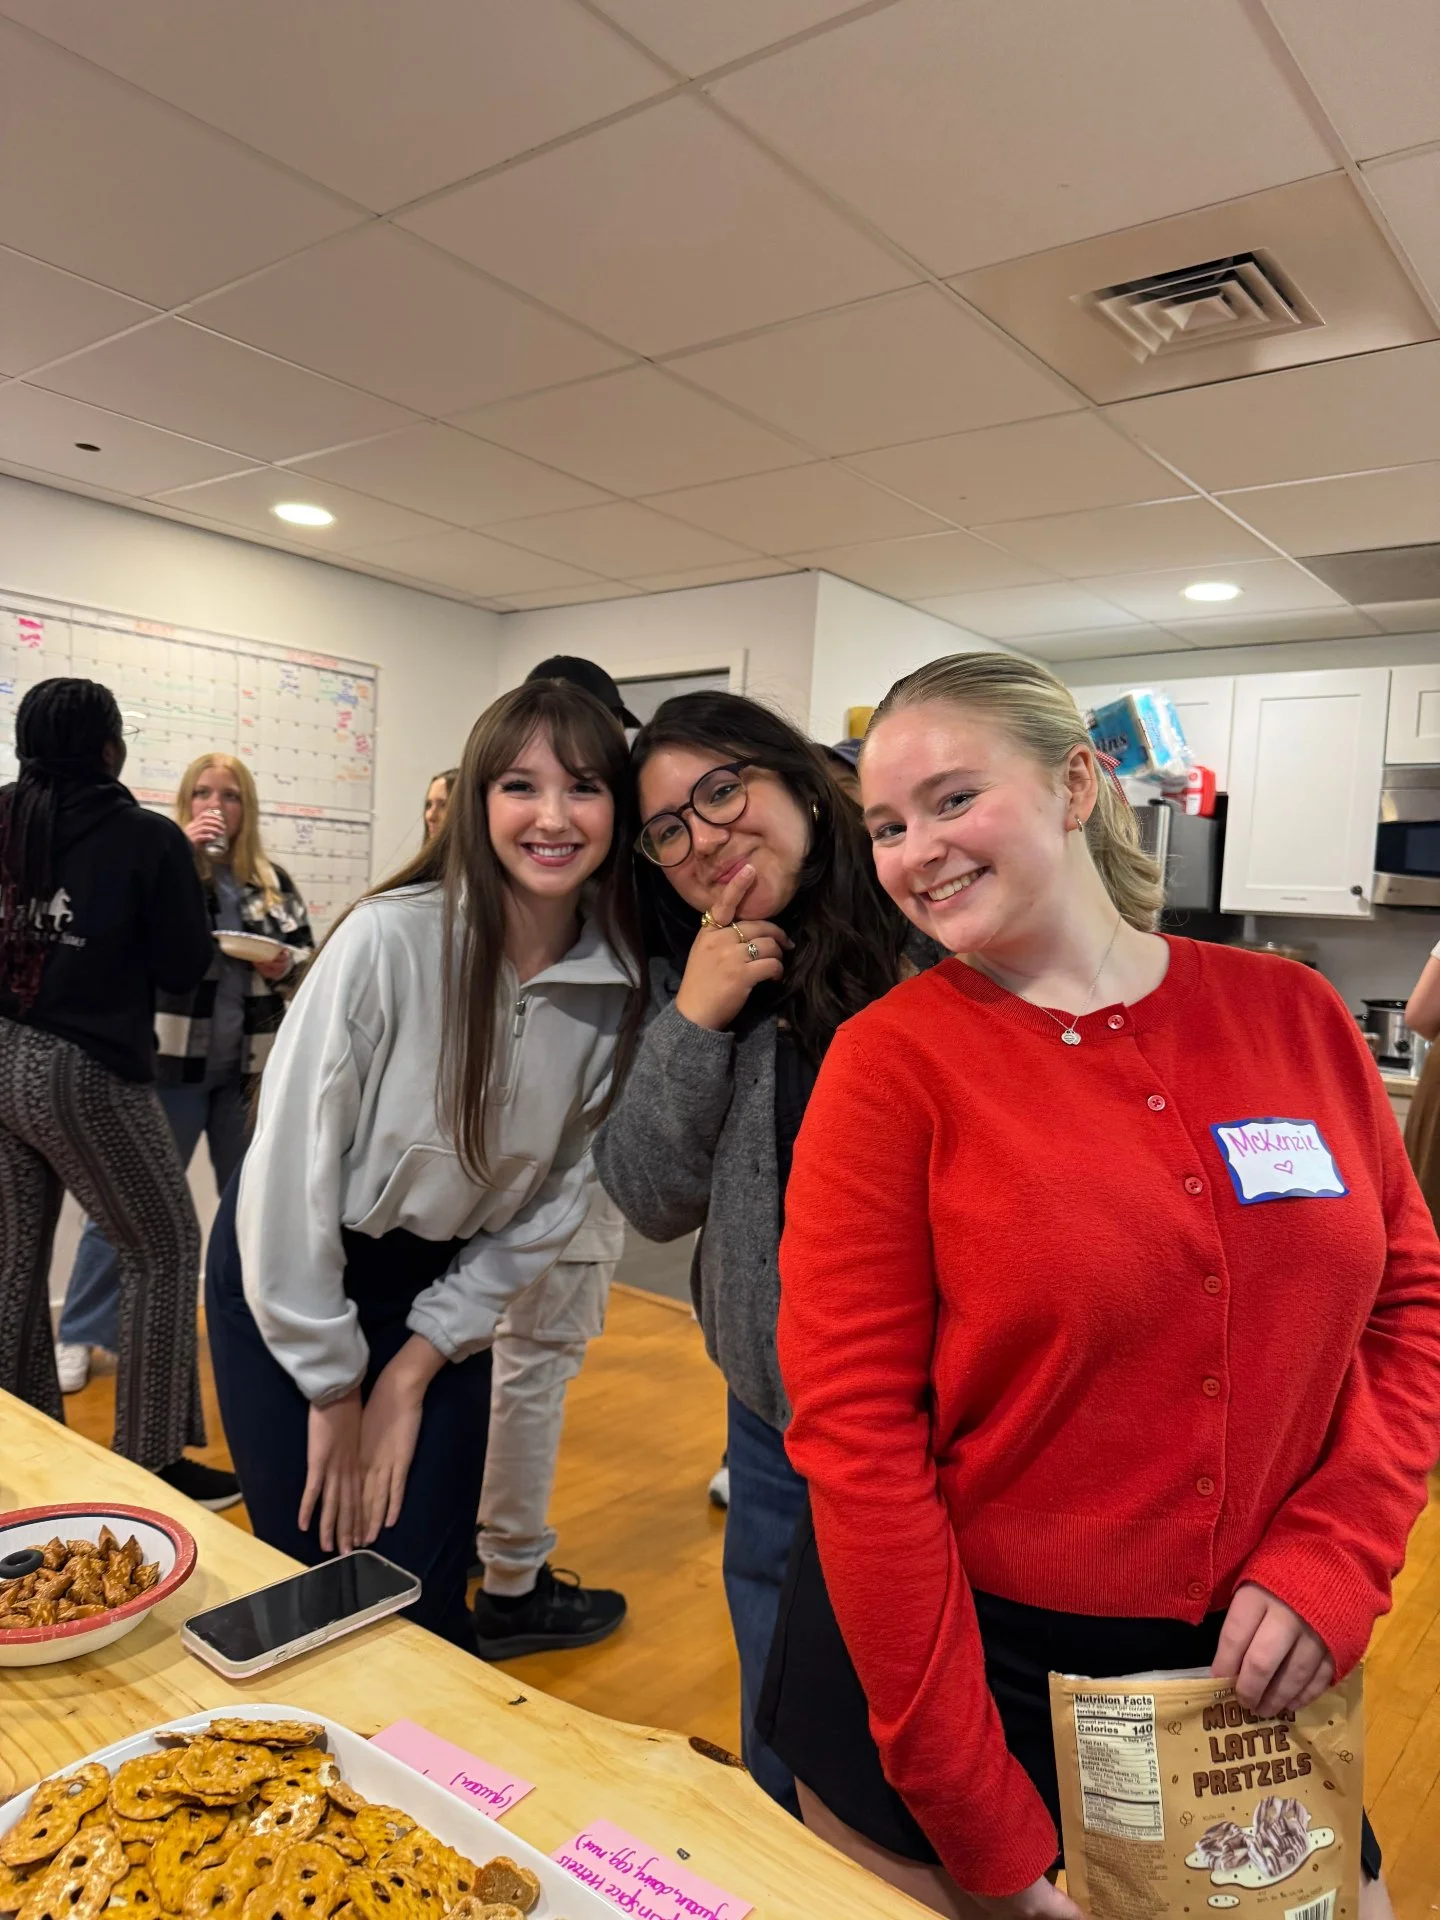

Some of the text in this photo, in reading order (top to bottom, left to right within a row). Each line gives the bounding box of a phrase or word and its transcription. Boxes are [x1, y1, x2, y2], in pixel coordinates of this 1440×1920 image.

[1227, 1127, 1319, 1157] McKenzie
[1075, 1695, 1153, 1706] Nutrition Facts
[1078, 1724, 1153, 1735] Calories 140
[1209, 1725, 1290, 1763] LATTE
[1193, 1753, 1312, 1797] PRETZELS
[605, 1883, 642, 1914] Spice
